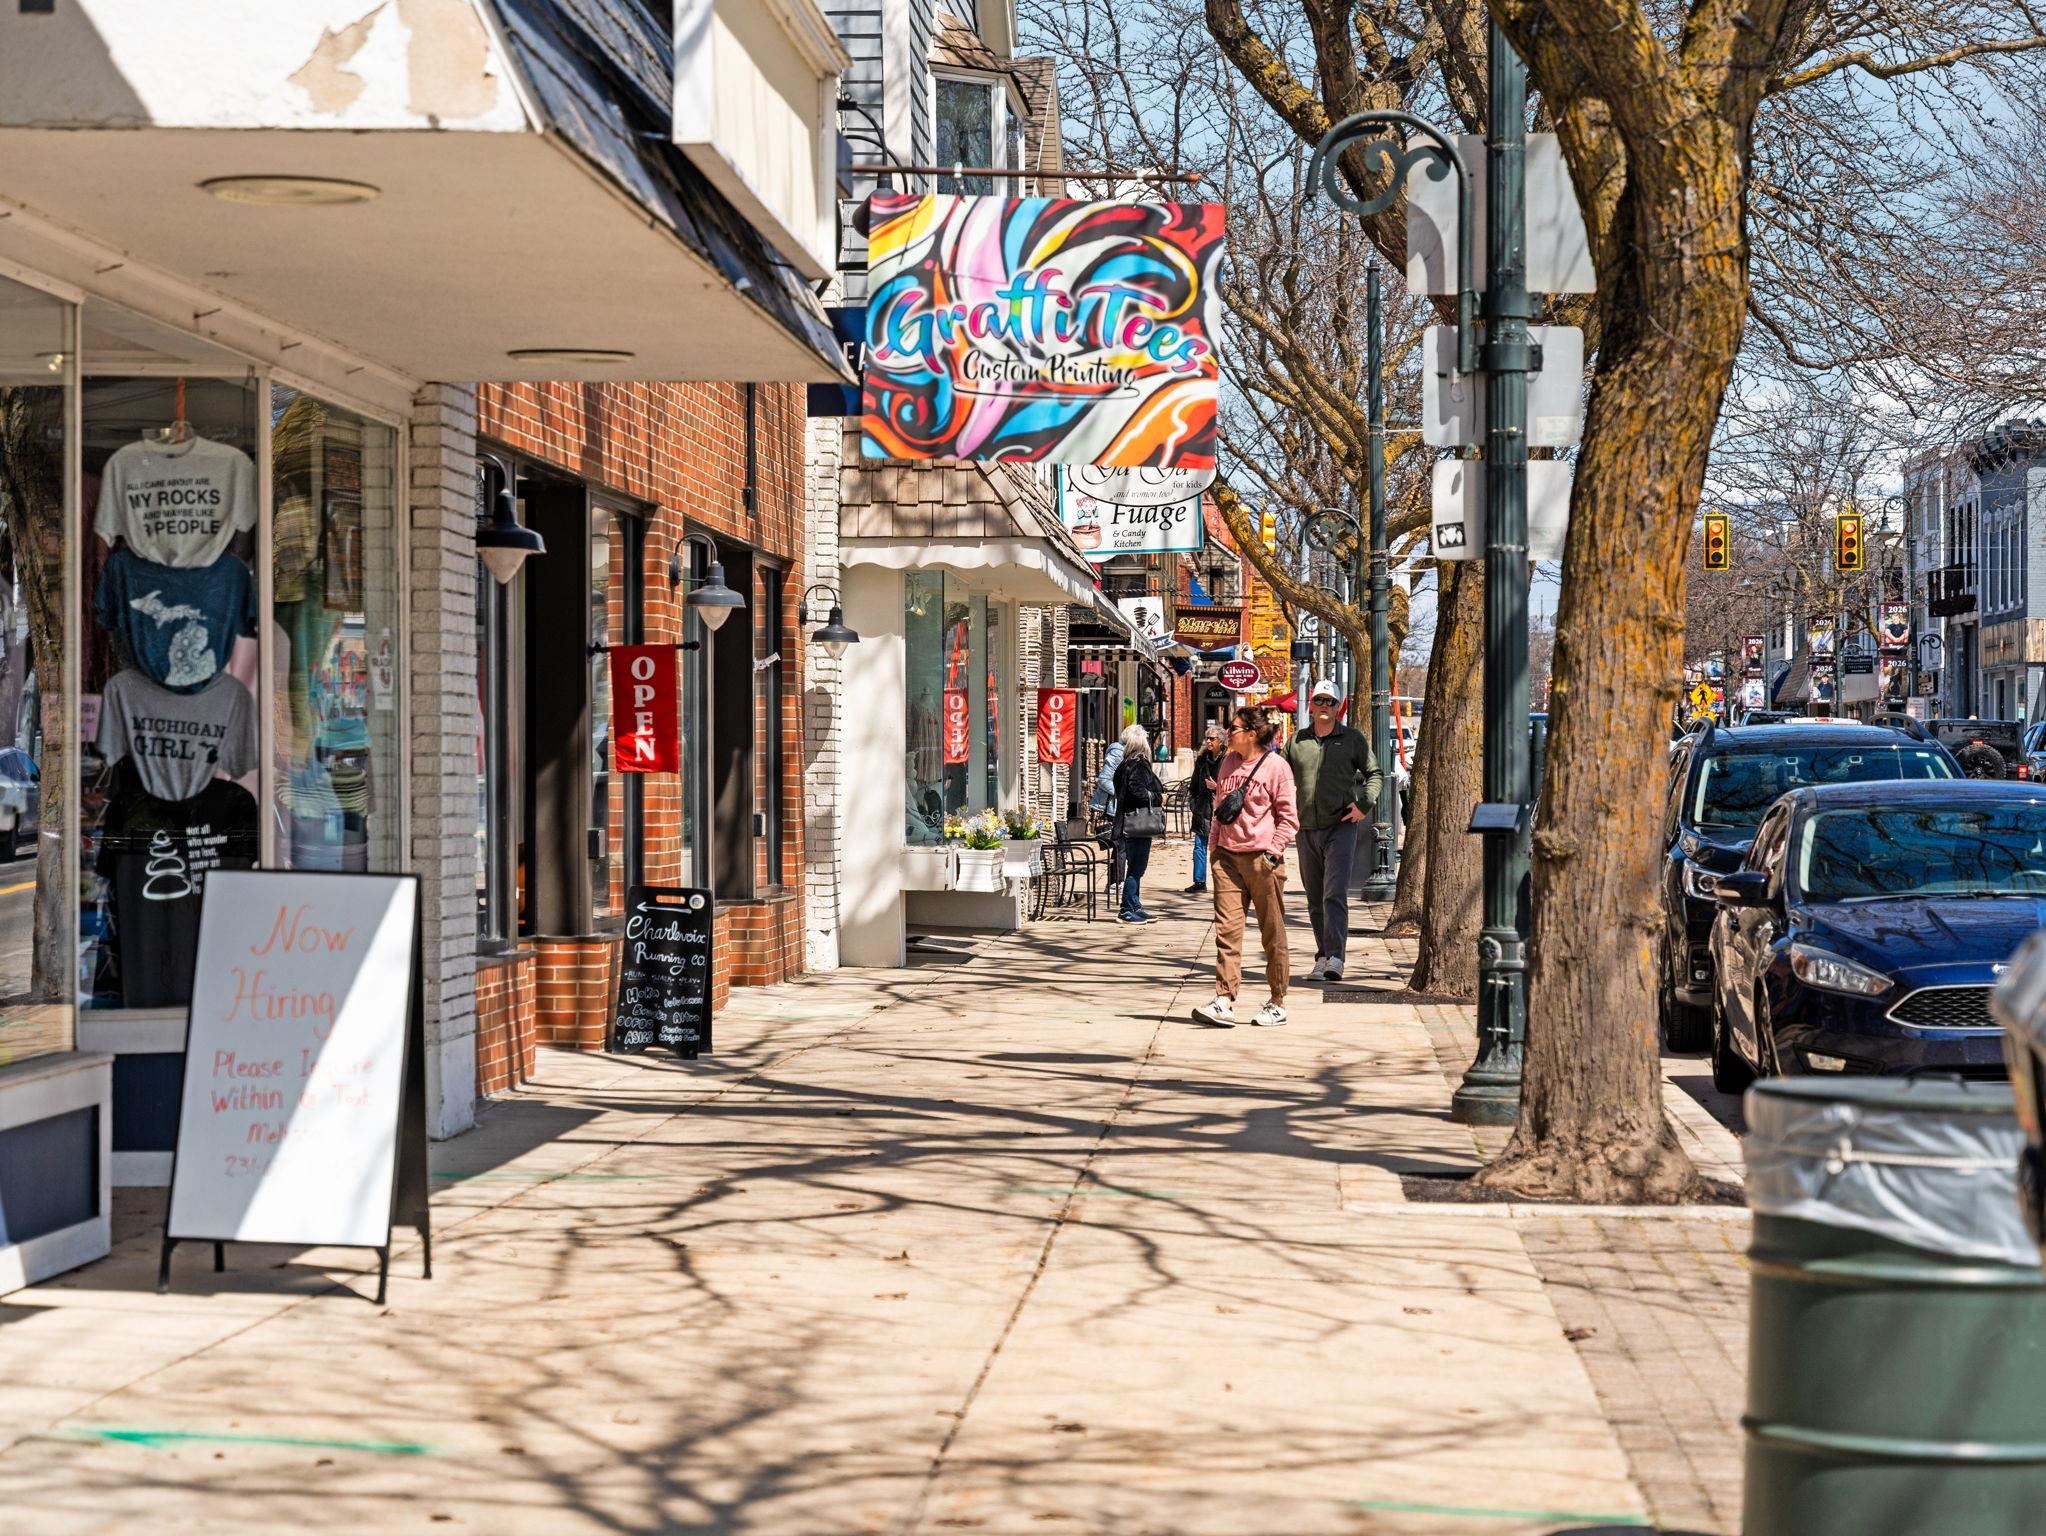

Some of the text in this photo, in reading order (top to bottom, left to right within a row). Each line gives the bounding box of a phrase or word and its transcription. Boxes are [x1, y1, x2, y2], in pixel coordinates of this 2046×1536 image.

[963, 350, 1137, 390] Custom Printing
[145, 480, 165, 489] CARE
[167, 478, 193, 487] ABOUT
[1113, 489, 1128, 498] and
[1173, 480, 1202, 488] for kids
[128, 489, 221, 510] MY ROCKS
[143, 508, 216, 520] AND MAYBE LIKE
[1110, 504, 1187, 531] Fudge
[155, 519, 221, 535] PEOPLE
[1112, 529, 1147, 538] & Candy
[1113, 539, 1142, 549] Kitchen
[1888, 605, 1907, 613] 2026
[1222, 666, 1255, 675] Kilwins
[630, 655, 656, 762] OPEN
[132, 715, 227, 739] MICHIGAN
[1049, 695, 1064, 758] OPEN
[134, 735, 196, 760] GIRL
[203, 834, 228, 846] wander
[250, 903, 355, 956] Now
[626, 915, 706, 944] Charlevoix
[634, 941, 686, 976] Running
[225, 967, 337, 1041] Hiring
[212, 1048, 283, 1079] Please
[211, 1084, 284, 1113] Within
